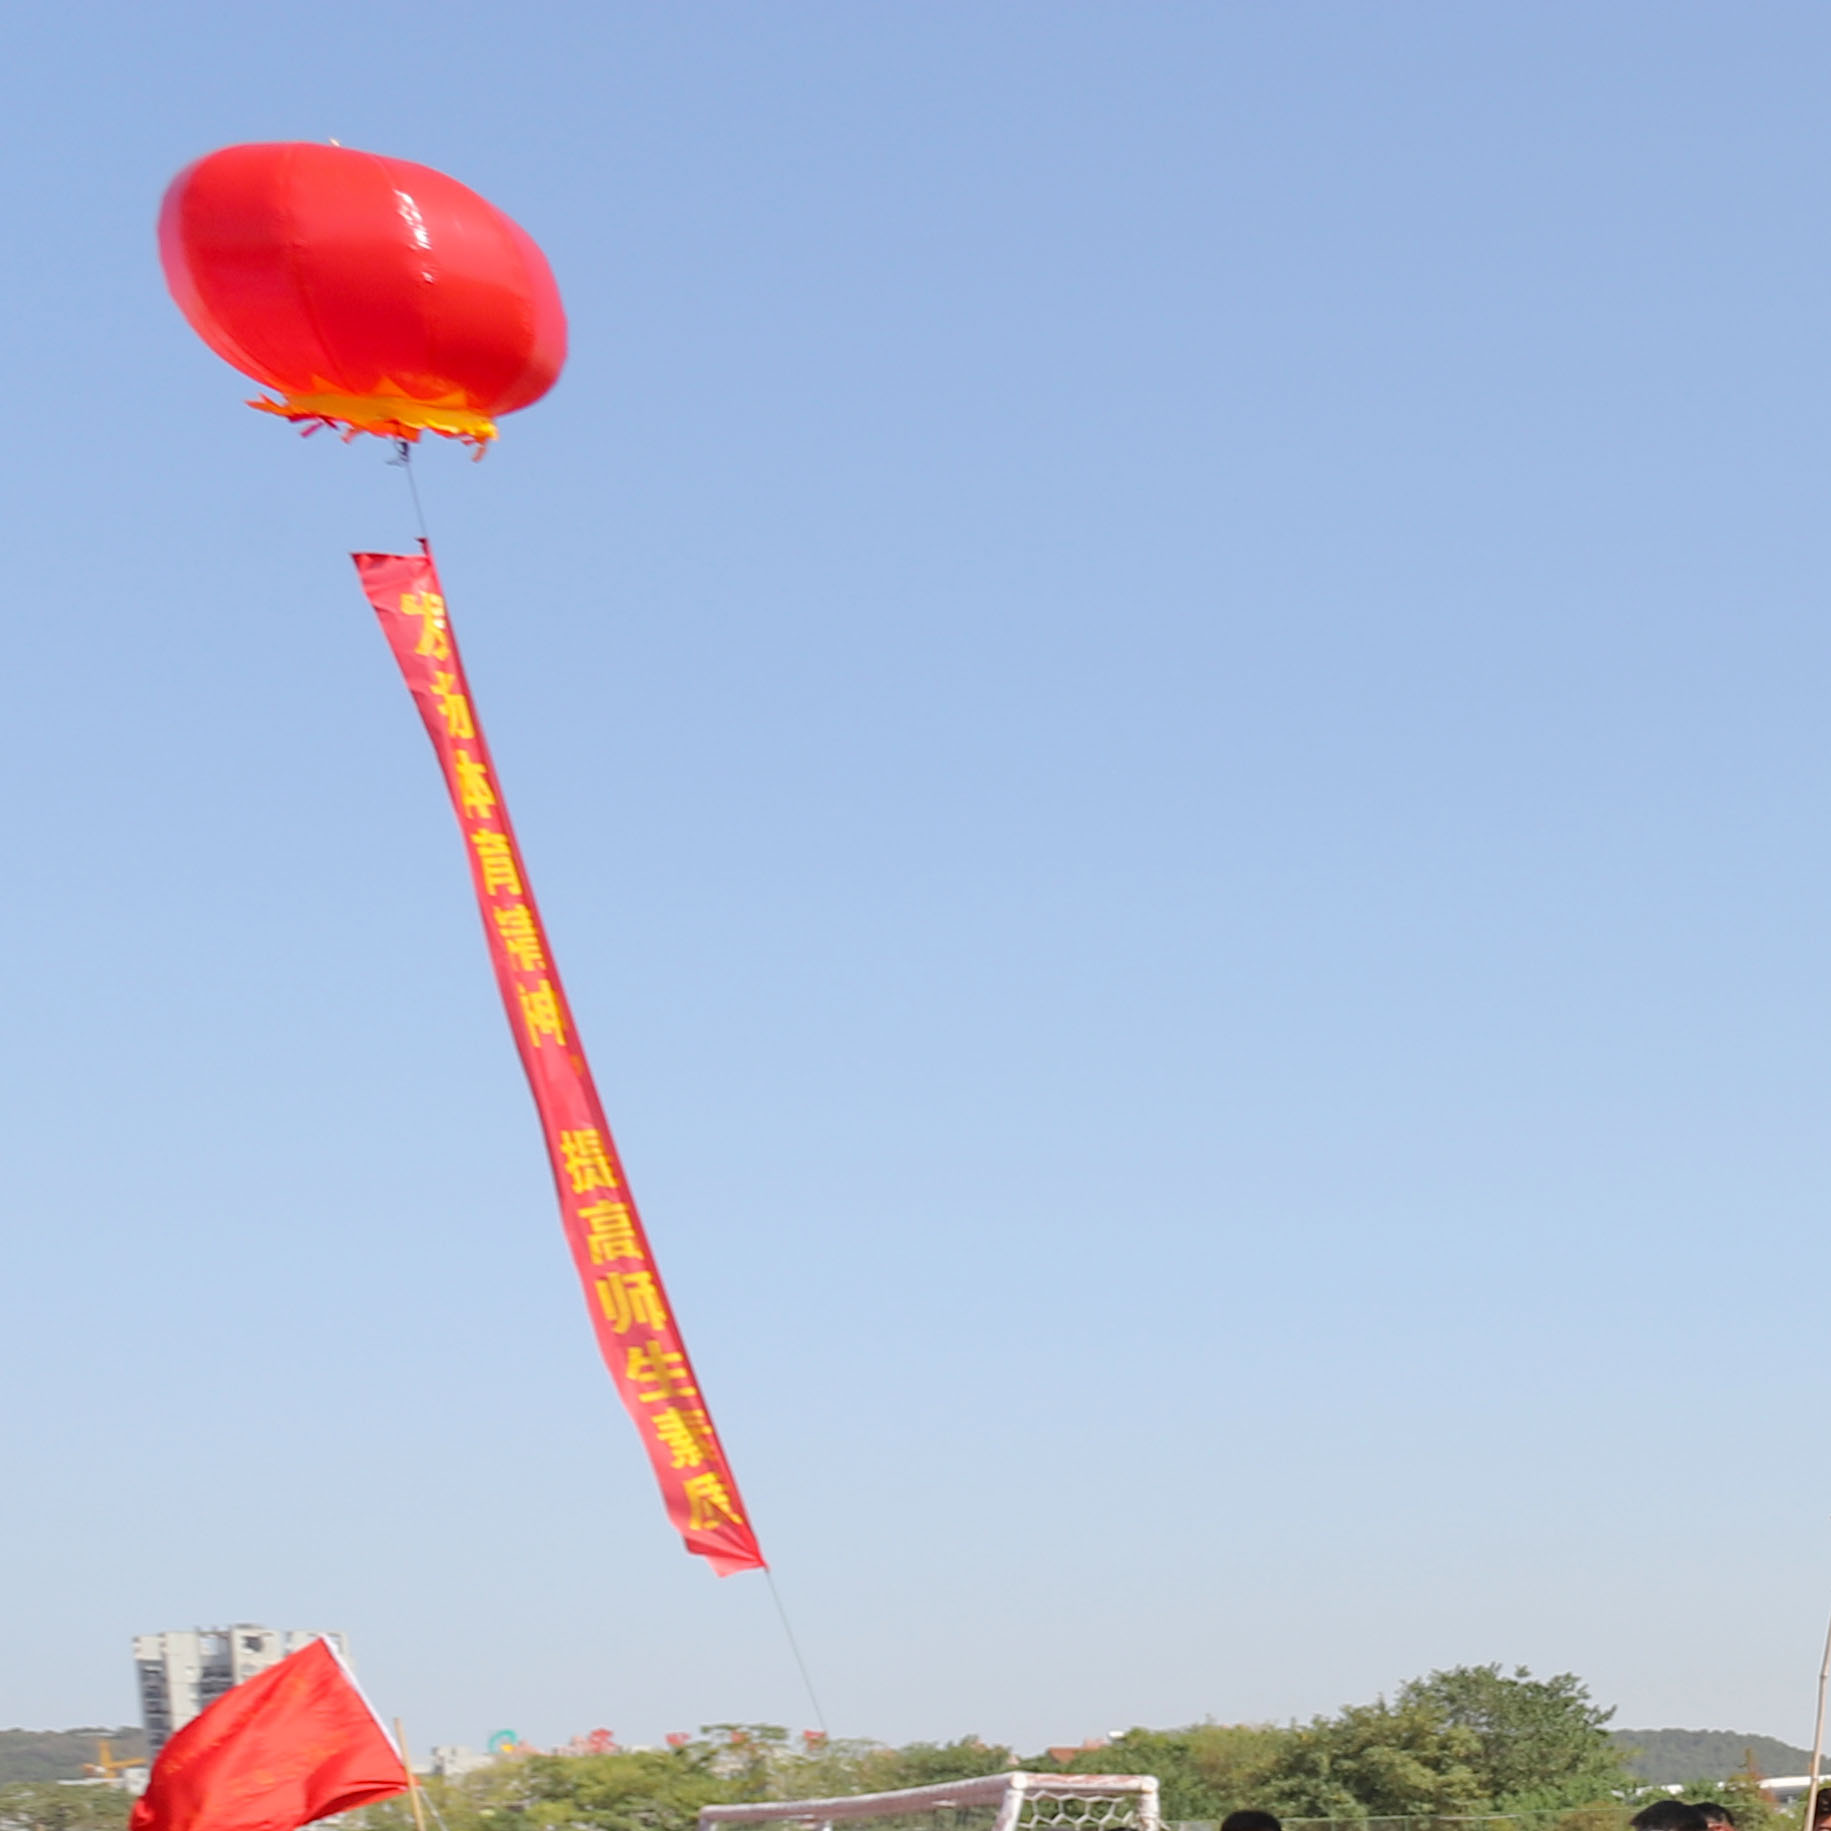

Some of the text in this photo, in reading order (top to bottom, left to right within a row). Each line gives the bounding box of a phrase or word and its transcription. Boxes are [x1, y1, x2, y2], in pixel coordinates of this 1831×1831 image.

[559, 1127, 742, 1532] 提高师生素质
